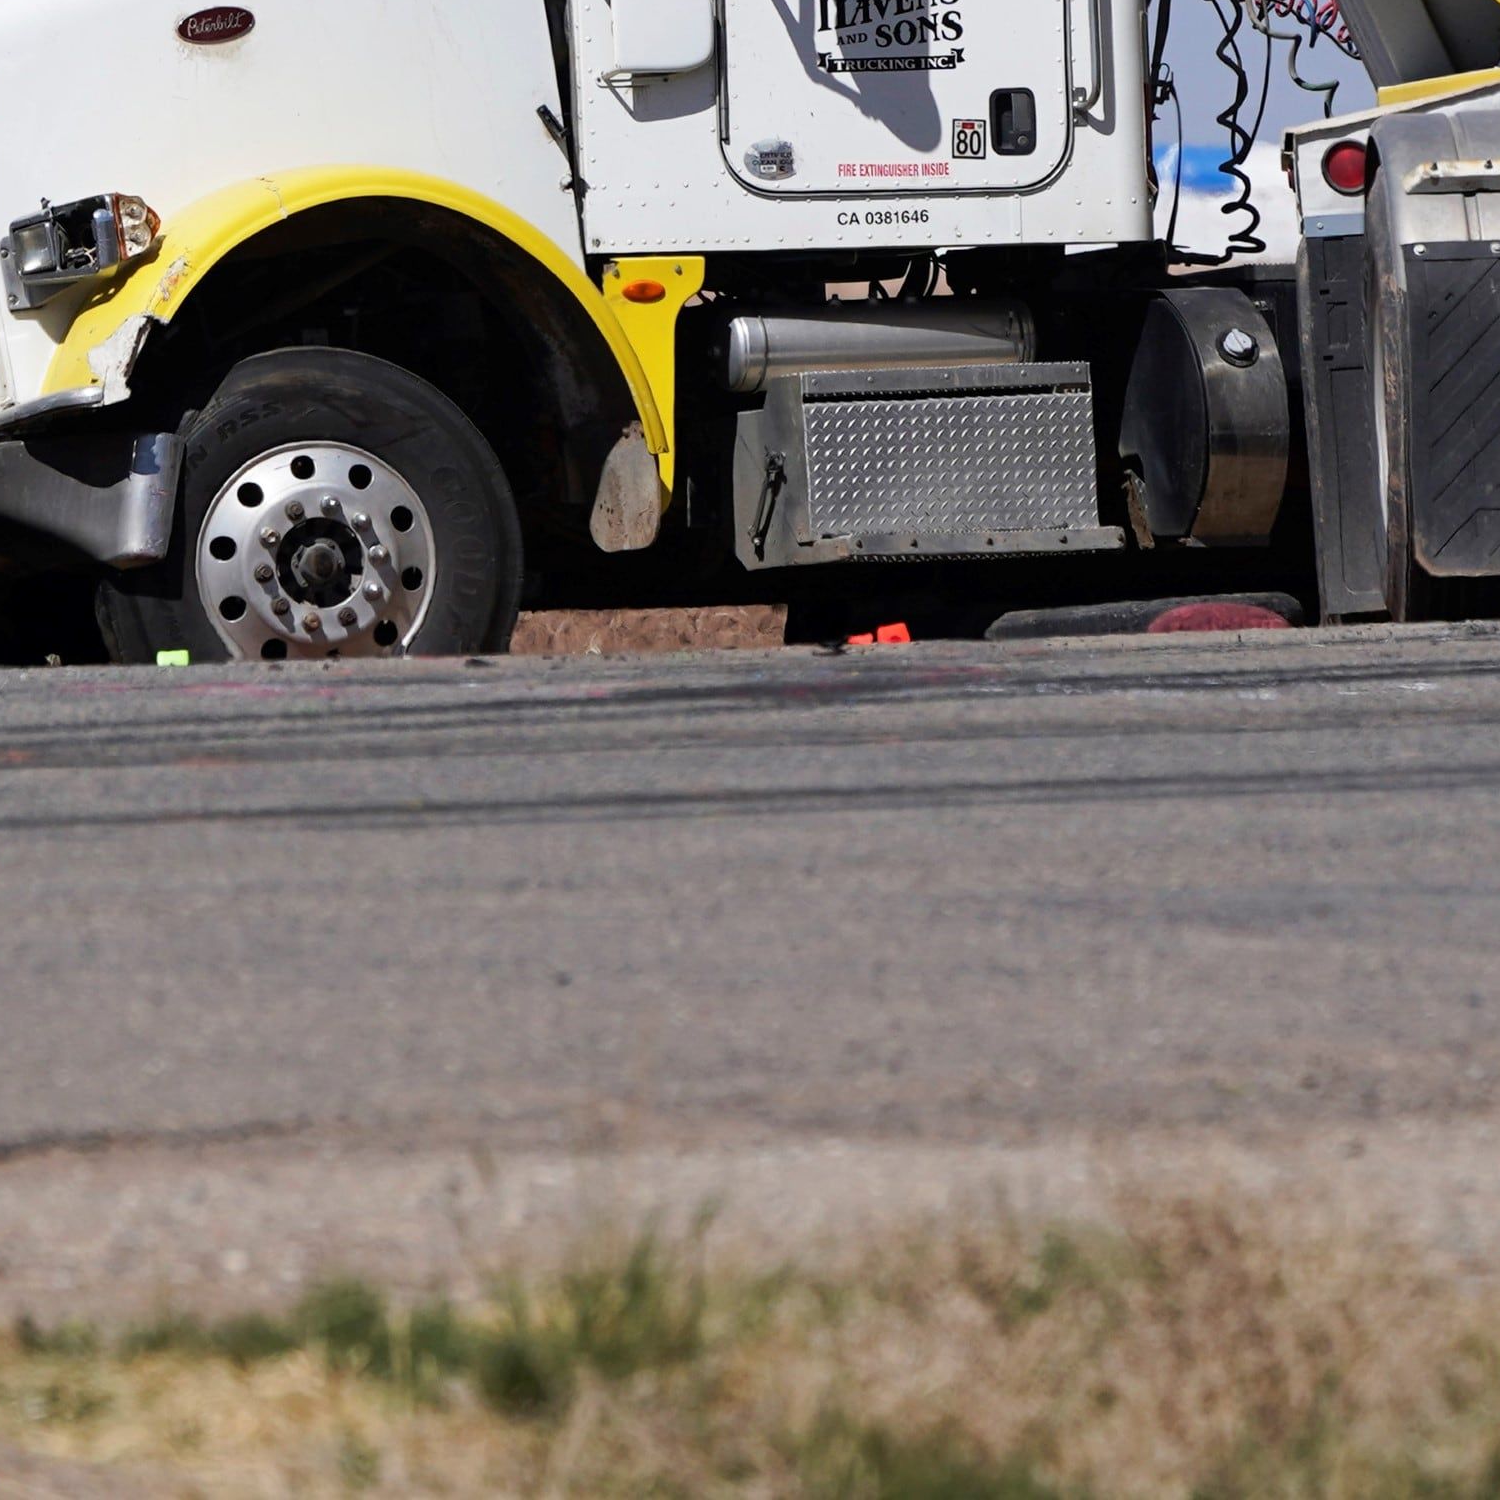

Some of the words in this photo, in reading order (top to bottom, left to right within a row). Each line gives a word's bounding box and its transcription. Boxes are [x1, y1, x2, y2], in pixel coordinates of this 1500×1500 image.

[186, 11, 247, 37] Peterbilt
[837, 31, 868, 46] AND
[875, 11, 964, 47] SONS
[833, 58, 916, 72] TRUCKING
[920, 56, 954, 70] INC.
[956, 129, 982, 156] 80
[838, 164, 856, 178] FIRE
[859, 163, 919, 177] EXTINGUISHER
[921, 162, 950, 176] INSIDE
[837, 212, 860, 226] CA
[865, 209, 930, 225] 0381646
